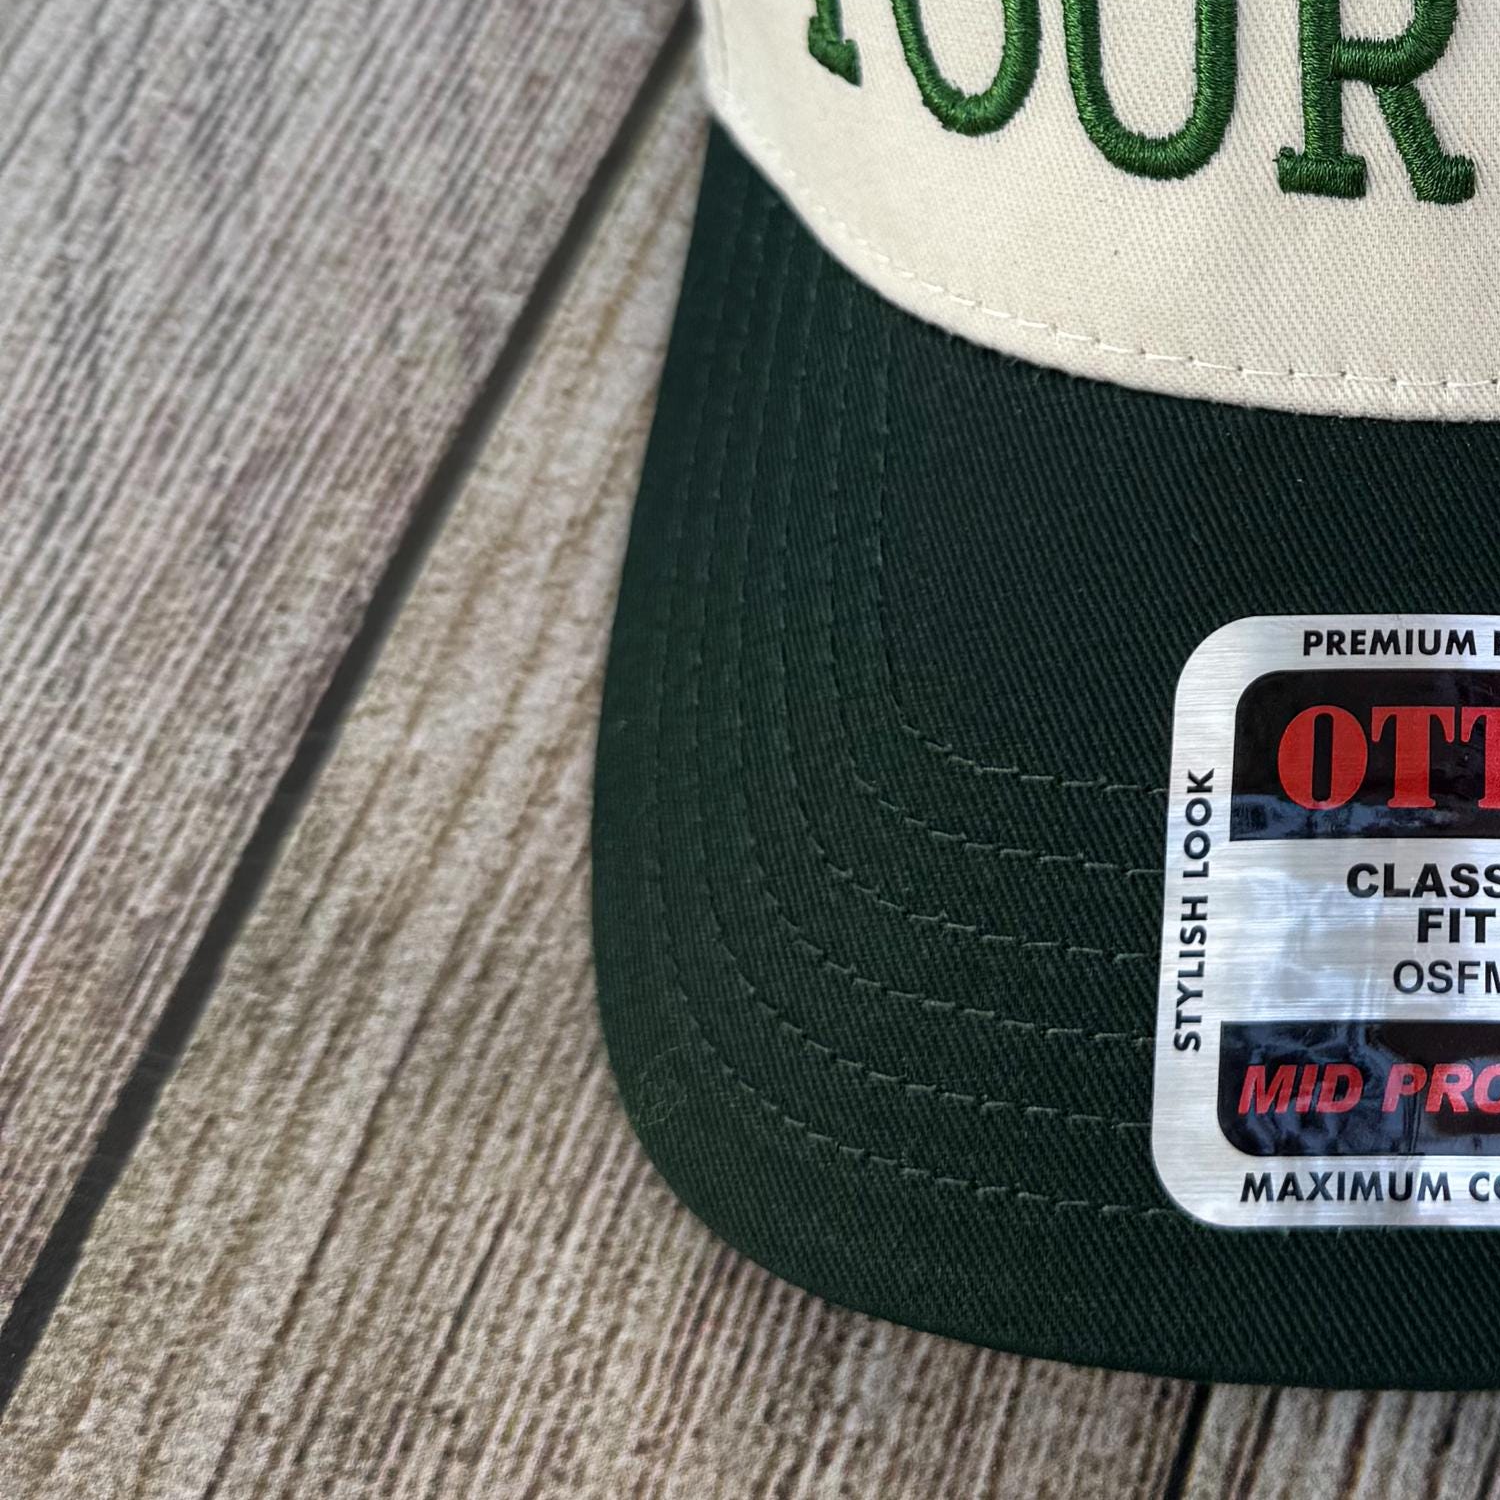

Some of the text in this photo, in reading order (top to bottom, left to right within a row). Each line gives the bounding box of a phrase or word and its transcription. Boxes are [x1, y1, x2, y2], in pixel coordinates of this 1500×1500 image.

[1302, 629, 1478, 657] PREMIUM
[1174, 768, 1215, 1052] STYLISH LOOK
[1416, 908, 1498, 944] FIT
[1237, 1064, 1364, 1115] MID
[1239, 1172, 1452, 1204] MAXIMUM
